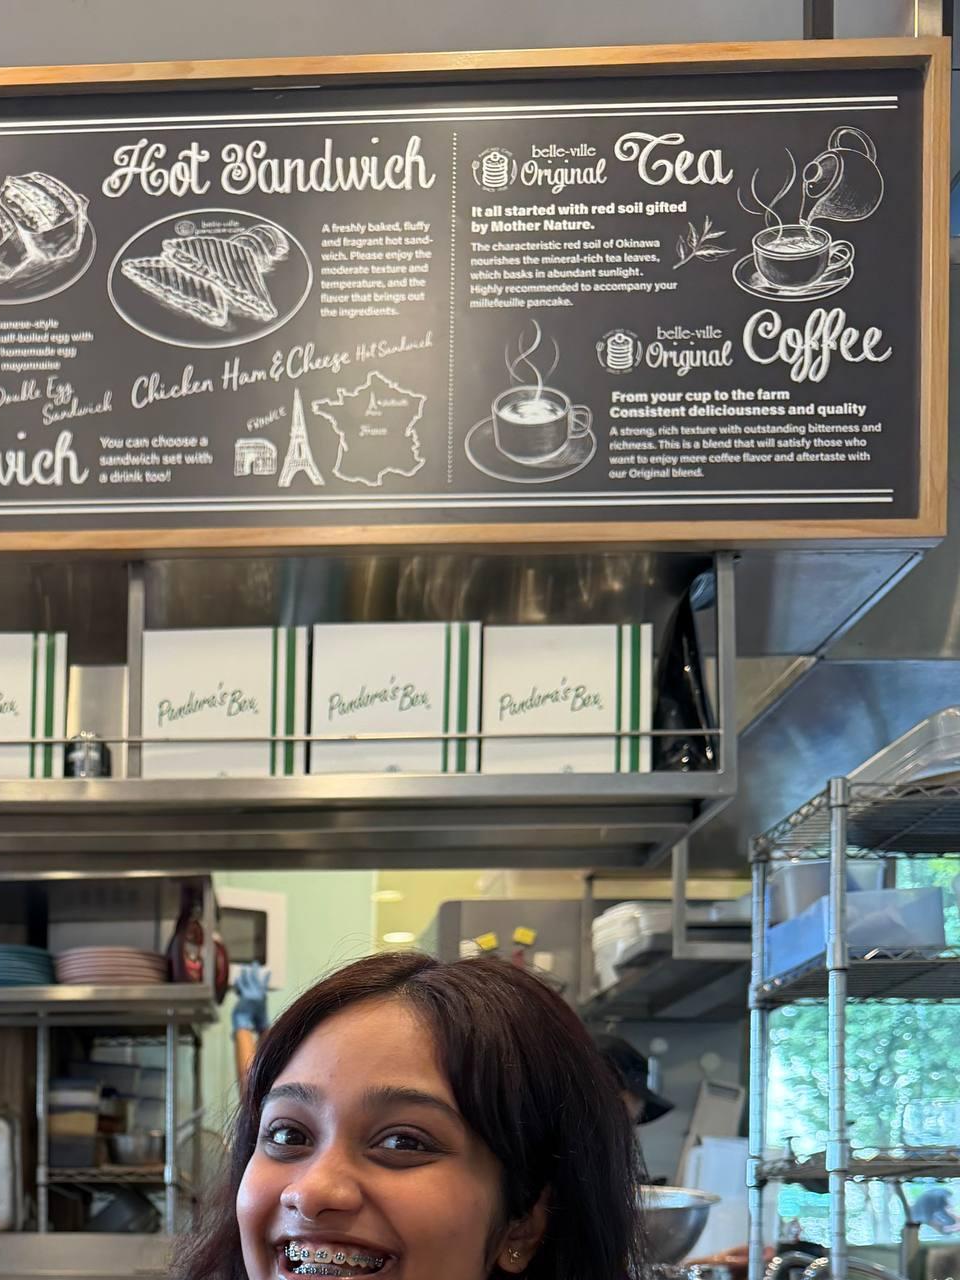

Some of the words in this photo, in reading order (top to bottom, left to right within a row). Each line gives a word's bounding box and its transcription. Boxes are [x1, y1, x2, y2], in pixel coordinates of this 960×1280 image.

[531, 143, 597, 158] belle-ville
[102, 138, 210, 198] Hot
[221, 136, 436, 195] Sandwich
[520, 158, 607, 195] Original
[614, 131, 733, 186] Tea
[471, 206, 482, 217] It
[484, 205, 502, 217] all
[504, 204, 556, 216] started
[557, 203, 588, 215] with
[591, 202, 615, 214] red
[617, 202, 644, 213] soil
[645, 201, 687, 215] gifted
[321, 224, 330, 232] A
[331, 223, 366, 234] freshly
[403, 221, 430, 232] fluffy
[471, 221, 488, 234] by
[490, 220, 540, 231] Mother
[542, 219, 594, 230] Nature.
[471, 242, 490, 251] The
[492, 240, 562, 251] characteristic
[562, 240, 581, 249] red
[582, 239, 602, 249] soil
[602, 239, 614, 248] of
[614, 238, 660, 249] Okinawa
[470, 255, 521, 265] nourishes
[522, 255, 540, 264] the
[540, 253, 604, 264] mineral-rich
[604, 254, 622, 262] tea
[470, 270, 502, 279] which
[502, 269, 534, 279] basks
[534, 269, 546, 278] in
[546, 268, 596, 278] abundant
[597, 267, 644, 278] sunlight.
[470, 284, 503, 296] Highly
[504, 282, 579, 293] recommended
[580, 283, 592, 291] to
[592, 283, 652, 292] accompany
[654, 282, 677, 292] your
[469, 297, 525, 308] millefeuille
[526, 297, 572, 308] pancake.
[656, 325, 723, 340] belle-ville
[645, 340, 734, 376] Original
[743, 308, 892, 382] Coffee
[131, 364, 213, 409] Chicken
[222, 357, 267, 391] Ham
[269, 350, 285, 382] &
[378, 330, 433, 358] Sandwich
[46, 375, 74, 406] Egg
[611, 391, 648, 402] From
[650, 392, 682, 404] your
[685, 392, 712, 403] cup
[714, 390, 729, 400] to
[731, 389, 754, 400] the
[756, 388, 790, 400] farm
[42, 390, 113, 426] Sandwich
[609, 405, 686, 417] Consistent
[688, 404, 786, 416] deliciousness
[788, 403, 815, 414] and
[817, 403, 866, 417] quality
[609, 426, 618, 435] A
[658, 425, 679, 435] rich
[680, 425, 717, 434] texture
[718, 424, 742, 434] with
[743, 423, 806, 435] outstanding
[807, 423, 860, 433] bitterness
[861, 423, 882, 432] and
[100, 437, 124, 448] You
[125, 438, 149, 448] can
[151, 435, 198, 447] choose
[199, 437, 208, 446] a
[99, 452, 160, 466] sandwich
[162, 453, 182, 464] set
[184, 452, 213, 464] with
[98, 473, 108, 483] a
[109, 470, 143, 482] drink
[158, 681, 228, 728] Pandora's
[328, 675, 399, 722] Pandora's
[499, 676, 571, 722] Pandora's
